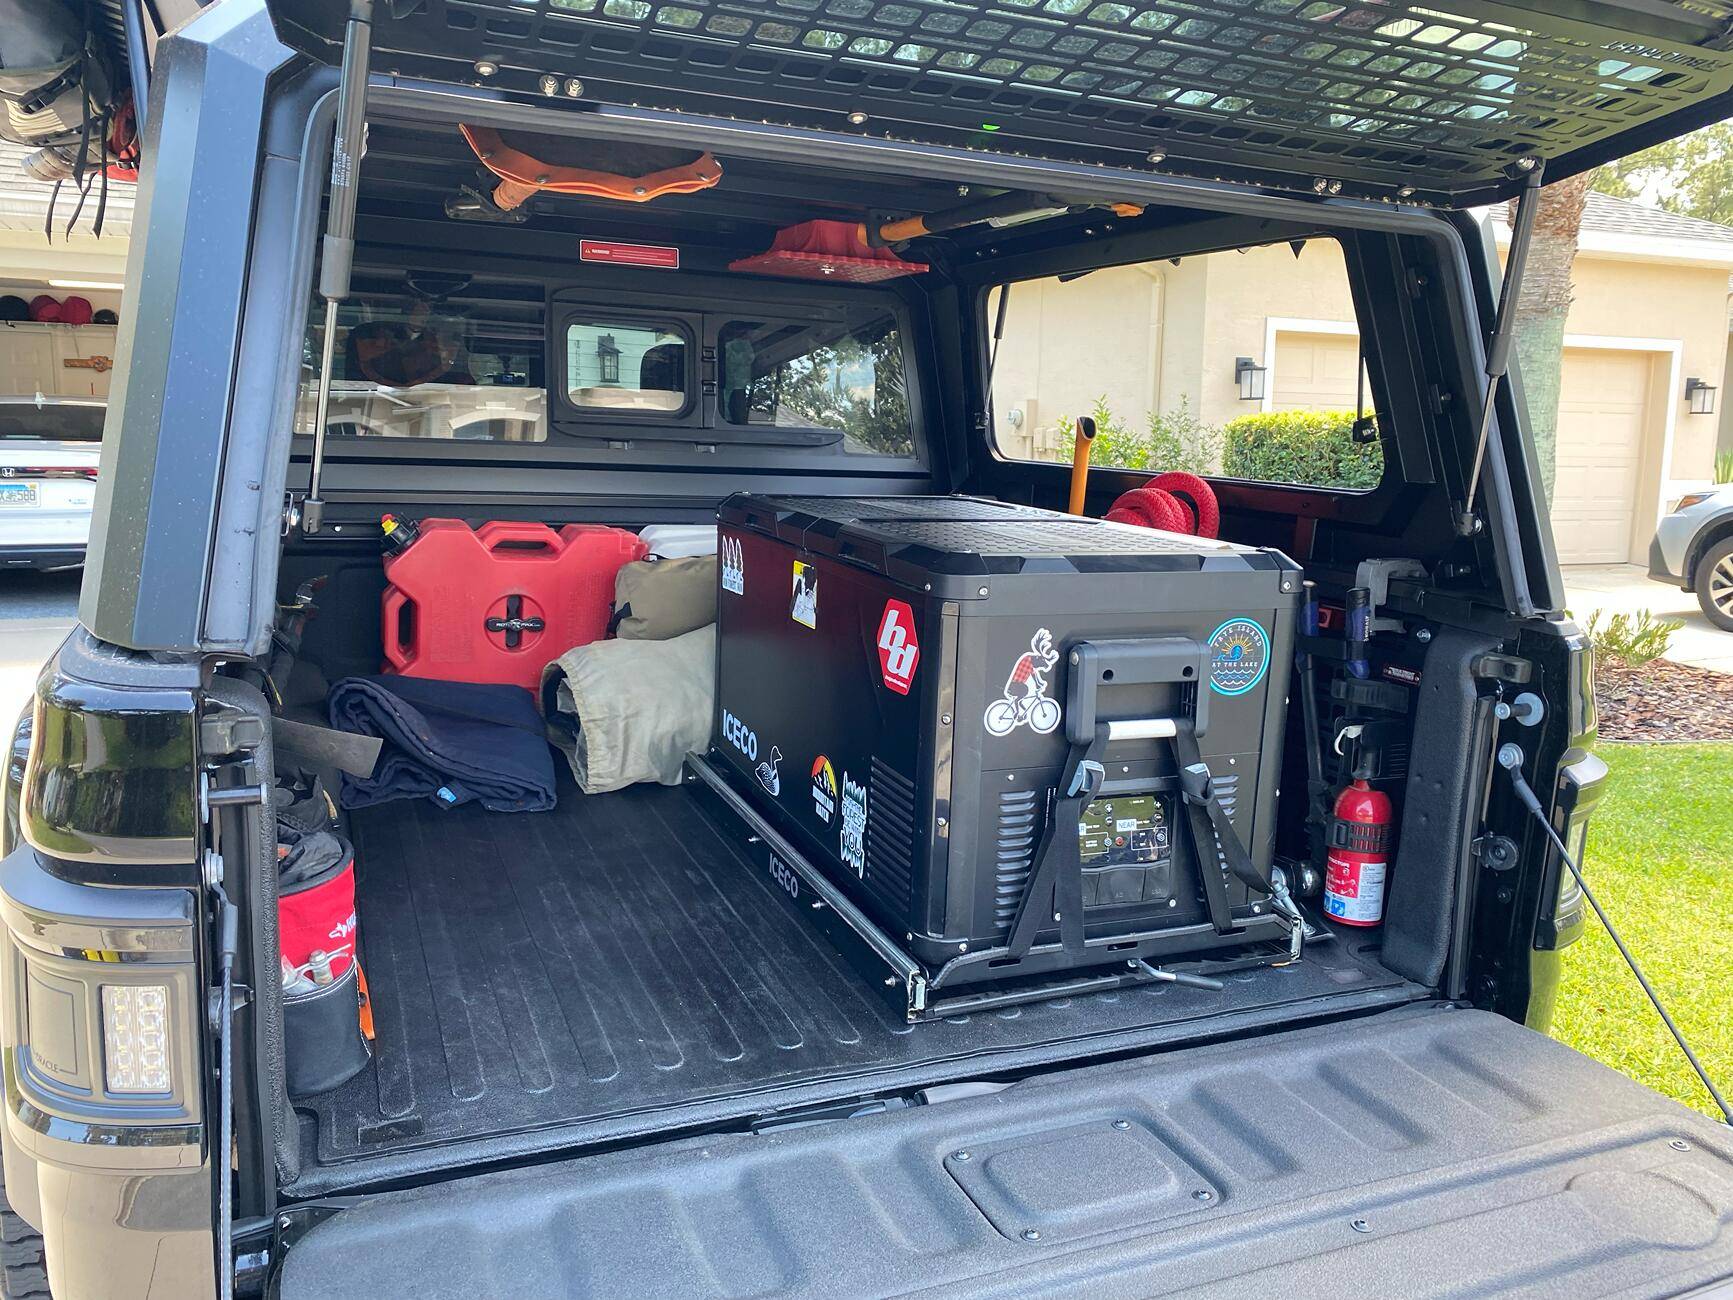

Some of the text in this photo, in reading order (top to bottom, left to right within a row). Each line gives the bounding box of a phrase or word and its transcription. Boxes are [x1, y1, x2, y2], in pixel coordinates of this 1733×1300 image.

[1237, 625, 1262, 646] ISLAND
[722, 709, 758, 761] ICECO
[1118, 821, 1136, 830] NEAR
[768, 853, 799, 898] ICECO
